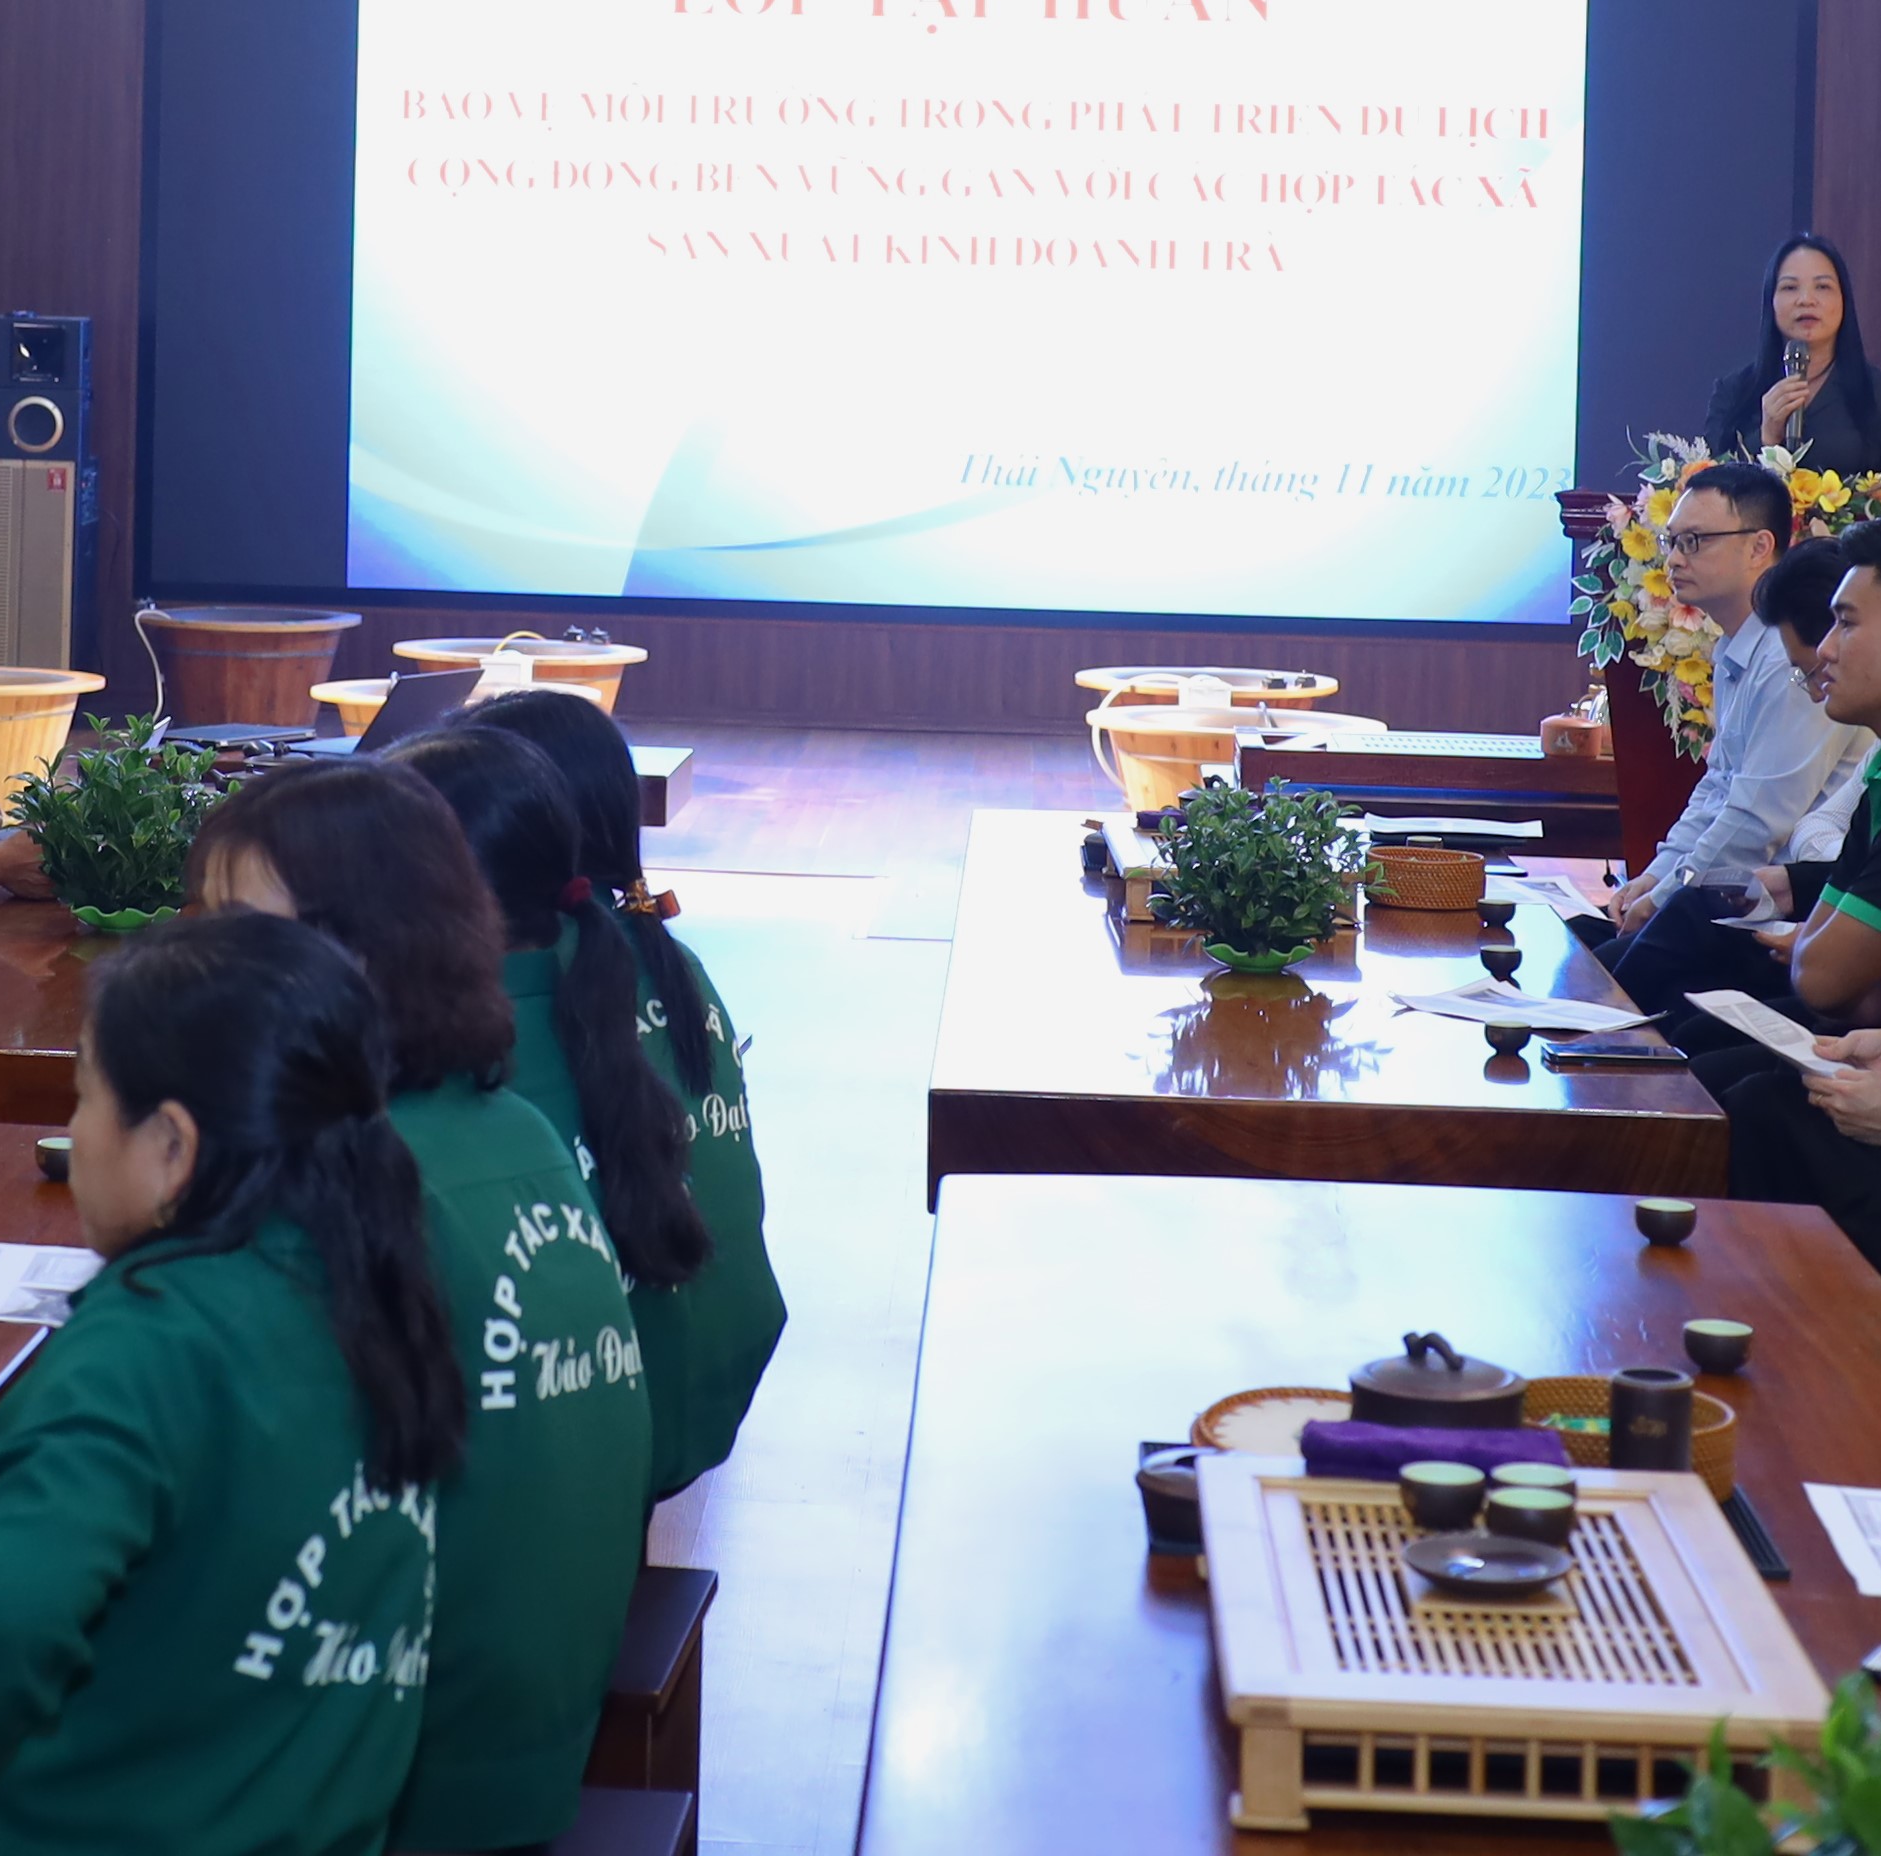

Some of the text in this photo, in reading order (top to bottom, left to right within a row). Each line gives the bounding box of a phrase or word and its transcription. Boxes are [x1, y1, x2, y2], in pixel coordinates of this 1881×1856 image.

[481, 1275, 527, 1410] HỢP
[504, 1203, 558, 1272] TÁC
[233, 1534, 326, 1680] HỢP
